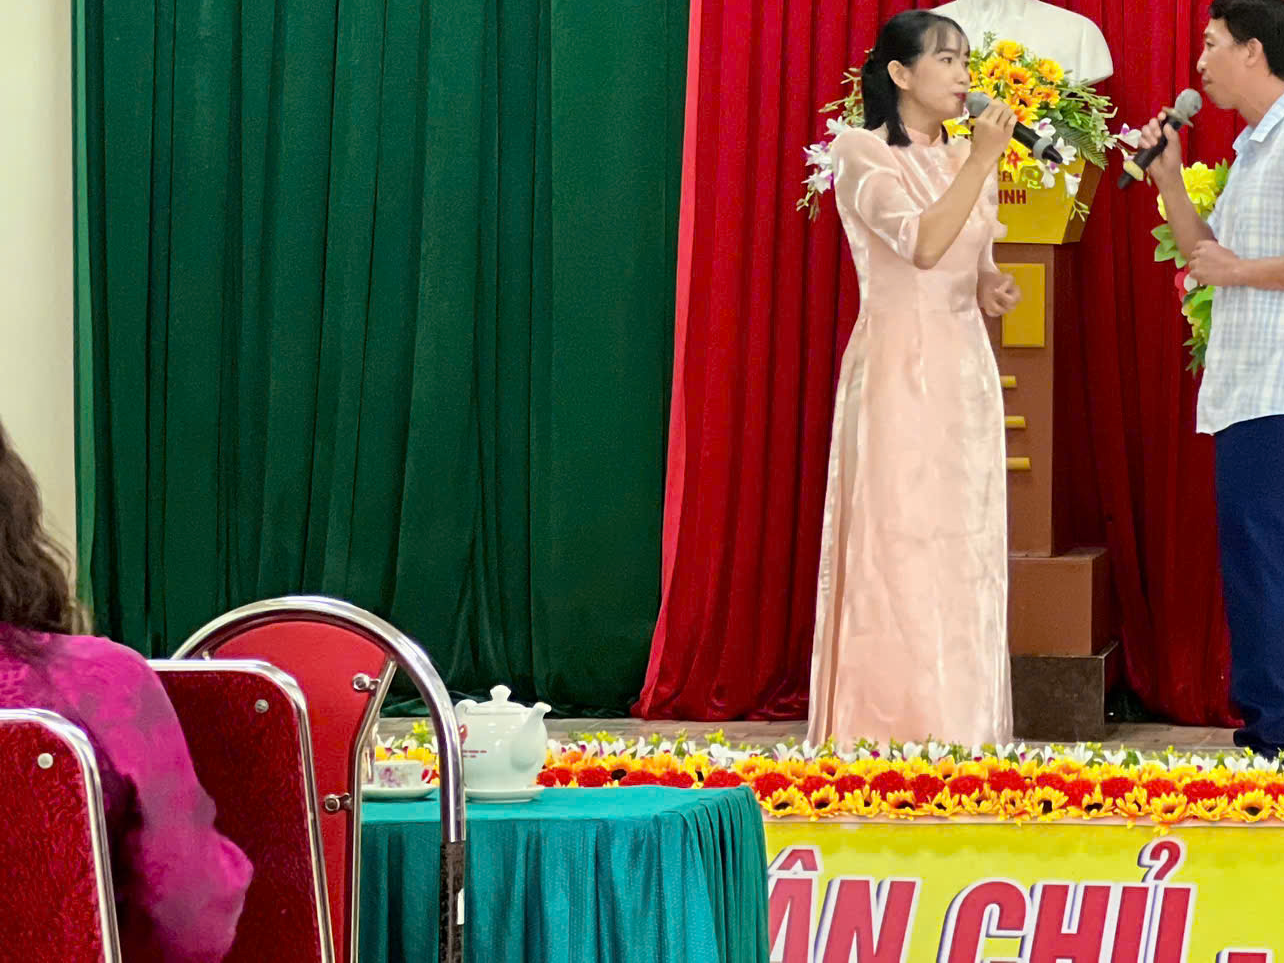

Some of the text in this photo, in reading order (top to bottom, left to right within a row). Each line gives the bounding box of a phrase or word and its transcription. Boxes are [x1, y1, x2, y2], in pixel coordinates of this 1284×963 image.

[998, 189, 1027, 205] INH
[768, 847, 919, 963] ÂN
[940, 839, 1195, 963] CHỦ
